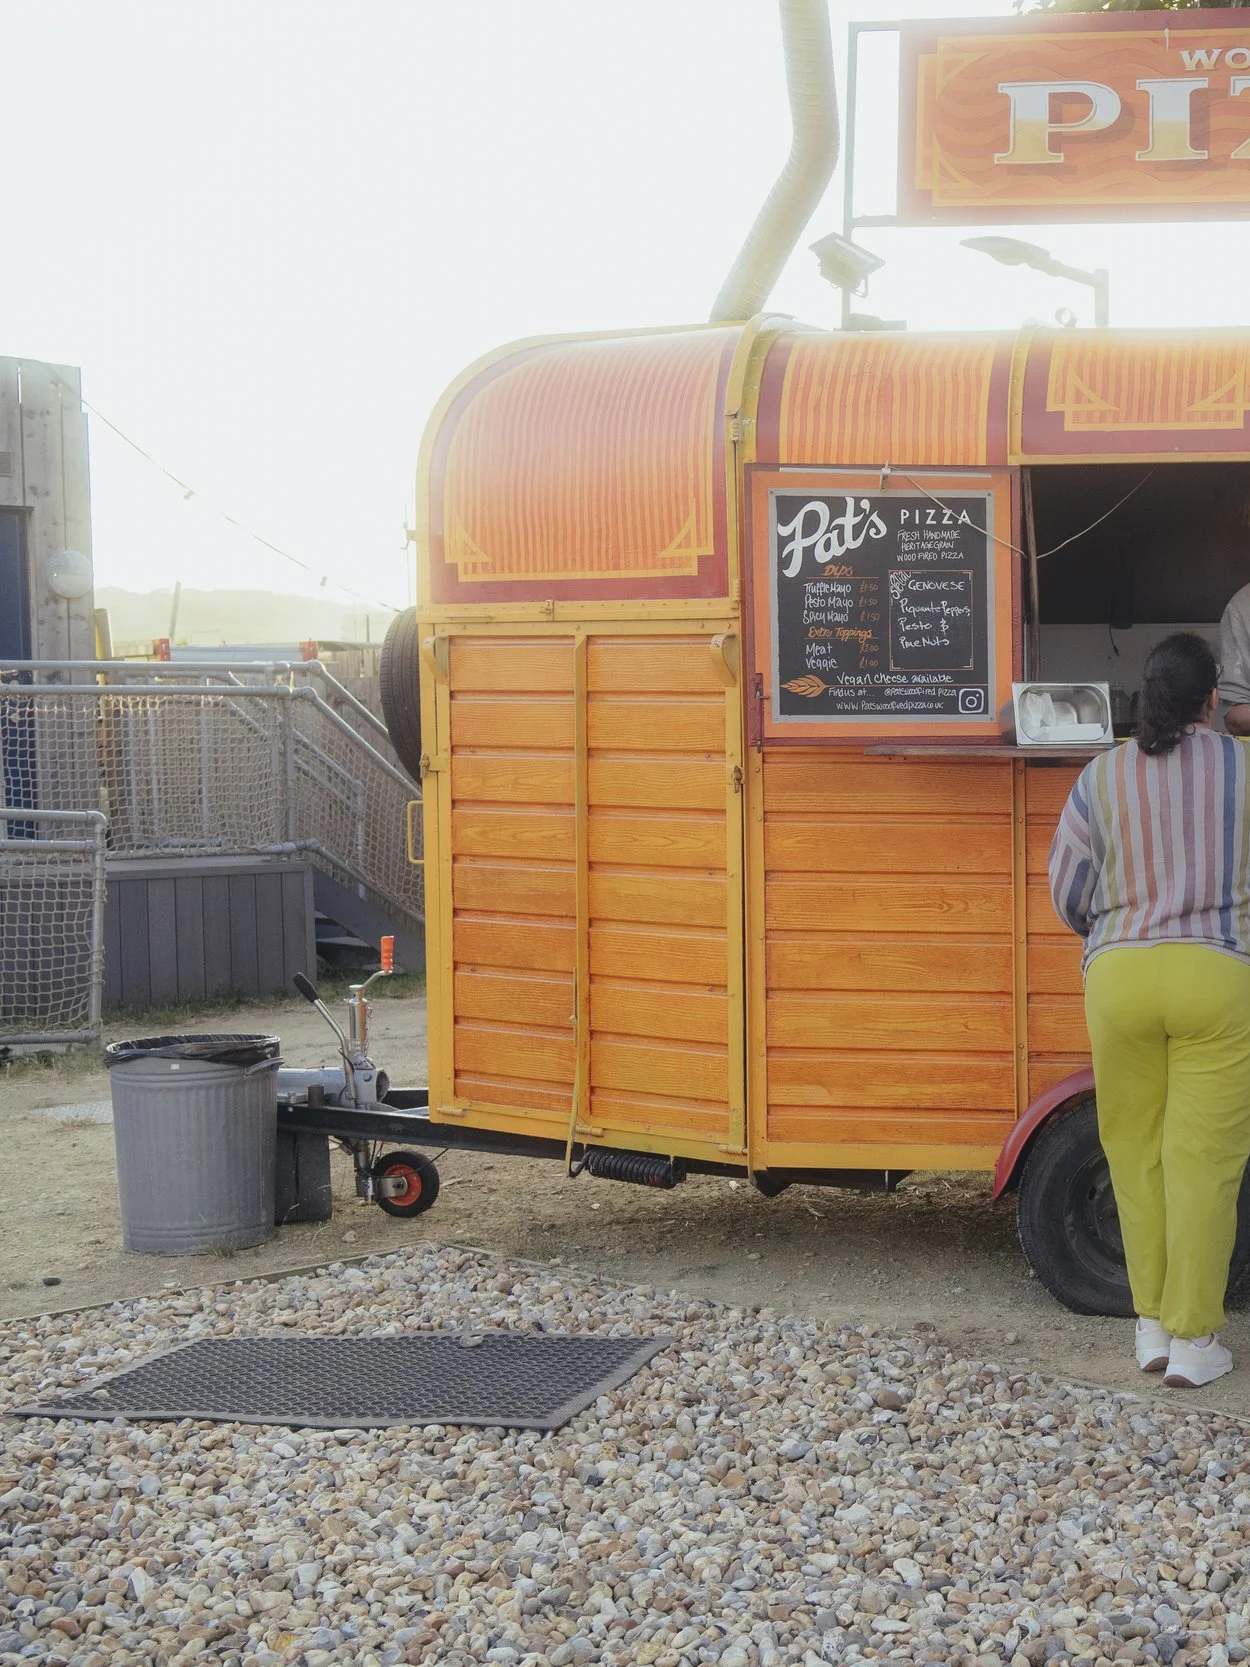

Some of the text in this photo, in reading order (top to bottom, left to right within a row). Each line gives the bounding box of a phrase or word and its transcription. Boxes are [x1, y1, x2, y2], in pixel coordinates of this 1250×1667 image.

[900, 509, 972, 525] PIZZA
[777, 496, 887, 578] Pat's
[897, 529, 961, 541] FRESH HANDMADE
[896, 551, 965, 562] WOOD FIRED PIZZA
[803, 582, 852, 597] Truffle Mayo
[907, 579, 965, 591] GENOVESE
[804, 593, 854, 613] Pesto Mayo
[827, 610, 849, 624] Mayo
[897, 617, 933, 632] Pesto
[835, 626, 873, 644] Toppings
[805, 642, 833, 657] Meat
[805, 656, 838, 671] Veggie
[836, 672, 872, 686] Vegan
